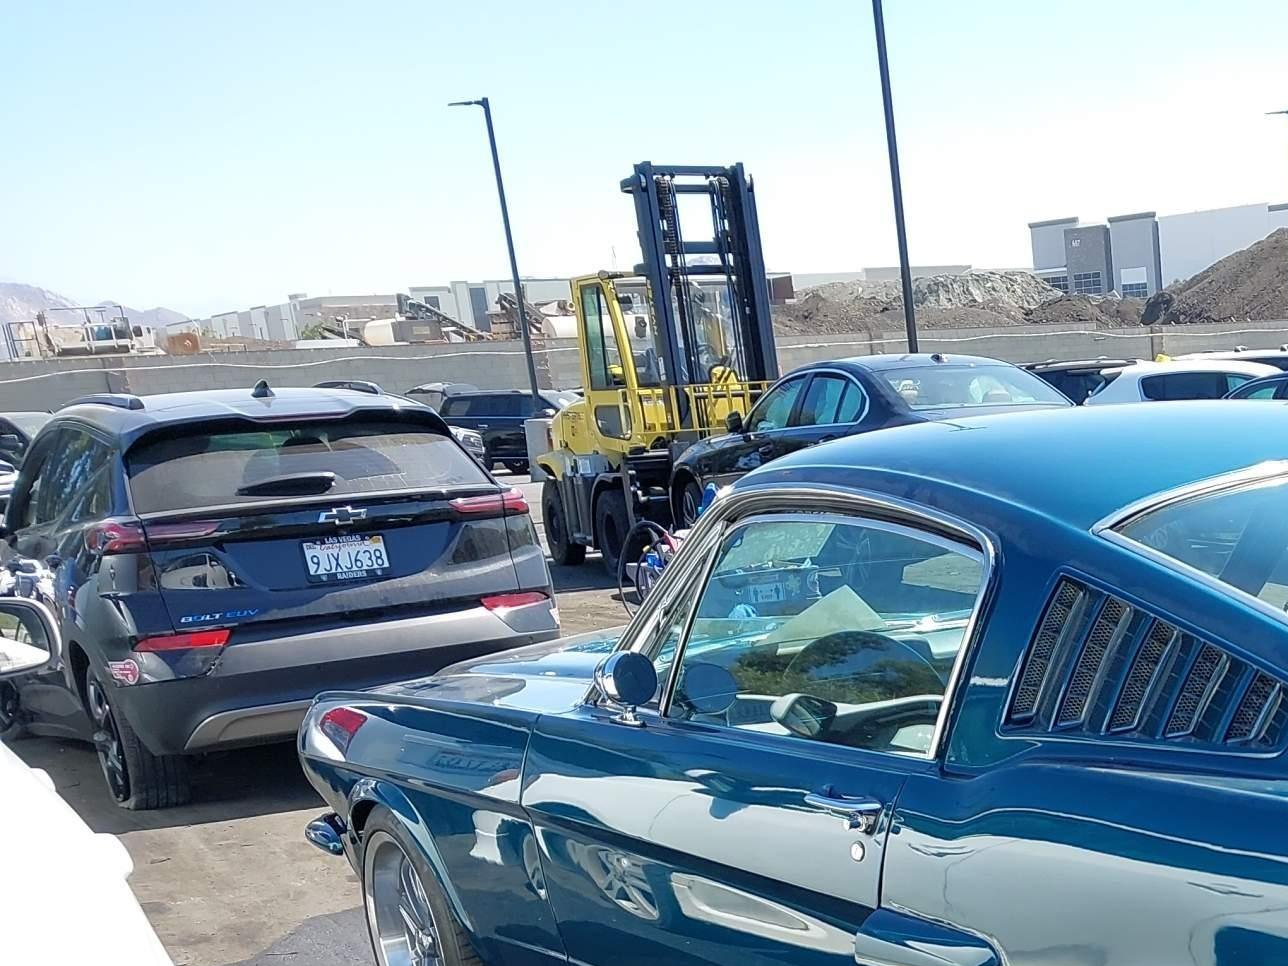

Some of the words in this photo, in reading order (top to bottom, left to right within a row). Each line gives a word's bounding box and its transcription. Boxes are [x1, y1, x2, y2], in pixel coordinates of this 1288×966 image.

[324, 536, 338, 544] LAS
[338, 534, 362, 543] VEGAS
[310, 548, 385, 574] 9JXJ638
[337, 570, 367, 580] RAIDERS
[180, 612, 224, 623] BOLT
[225, 608, 259, 618] EUV
